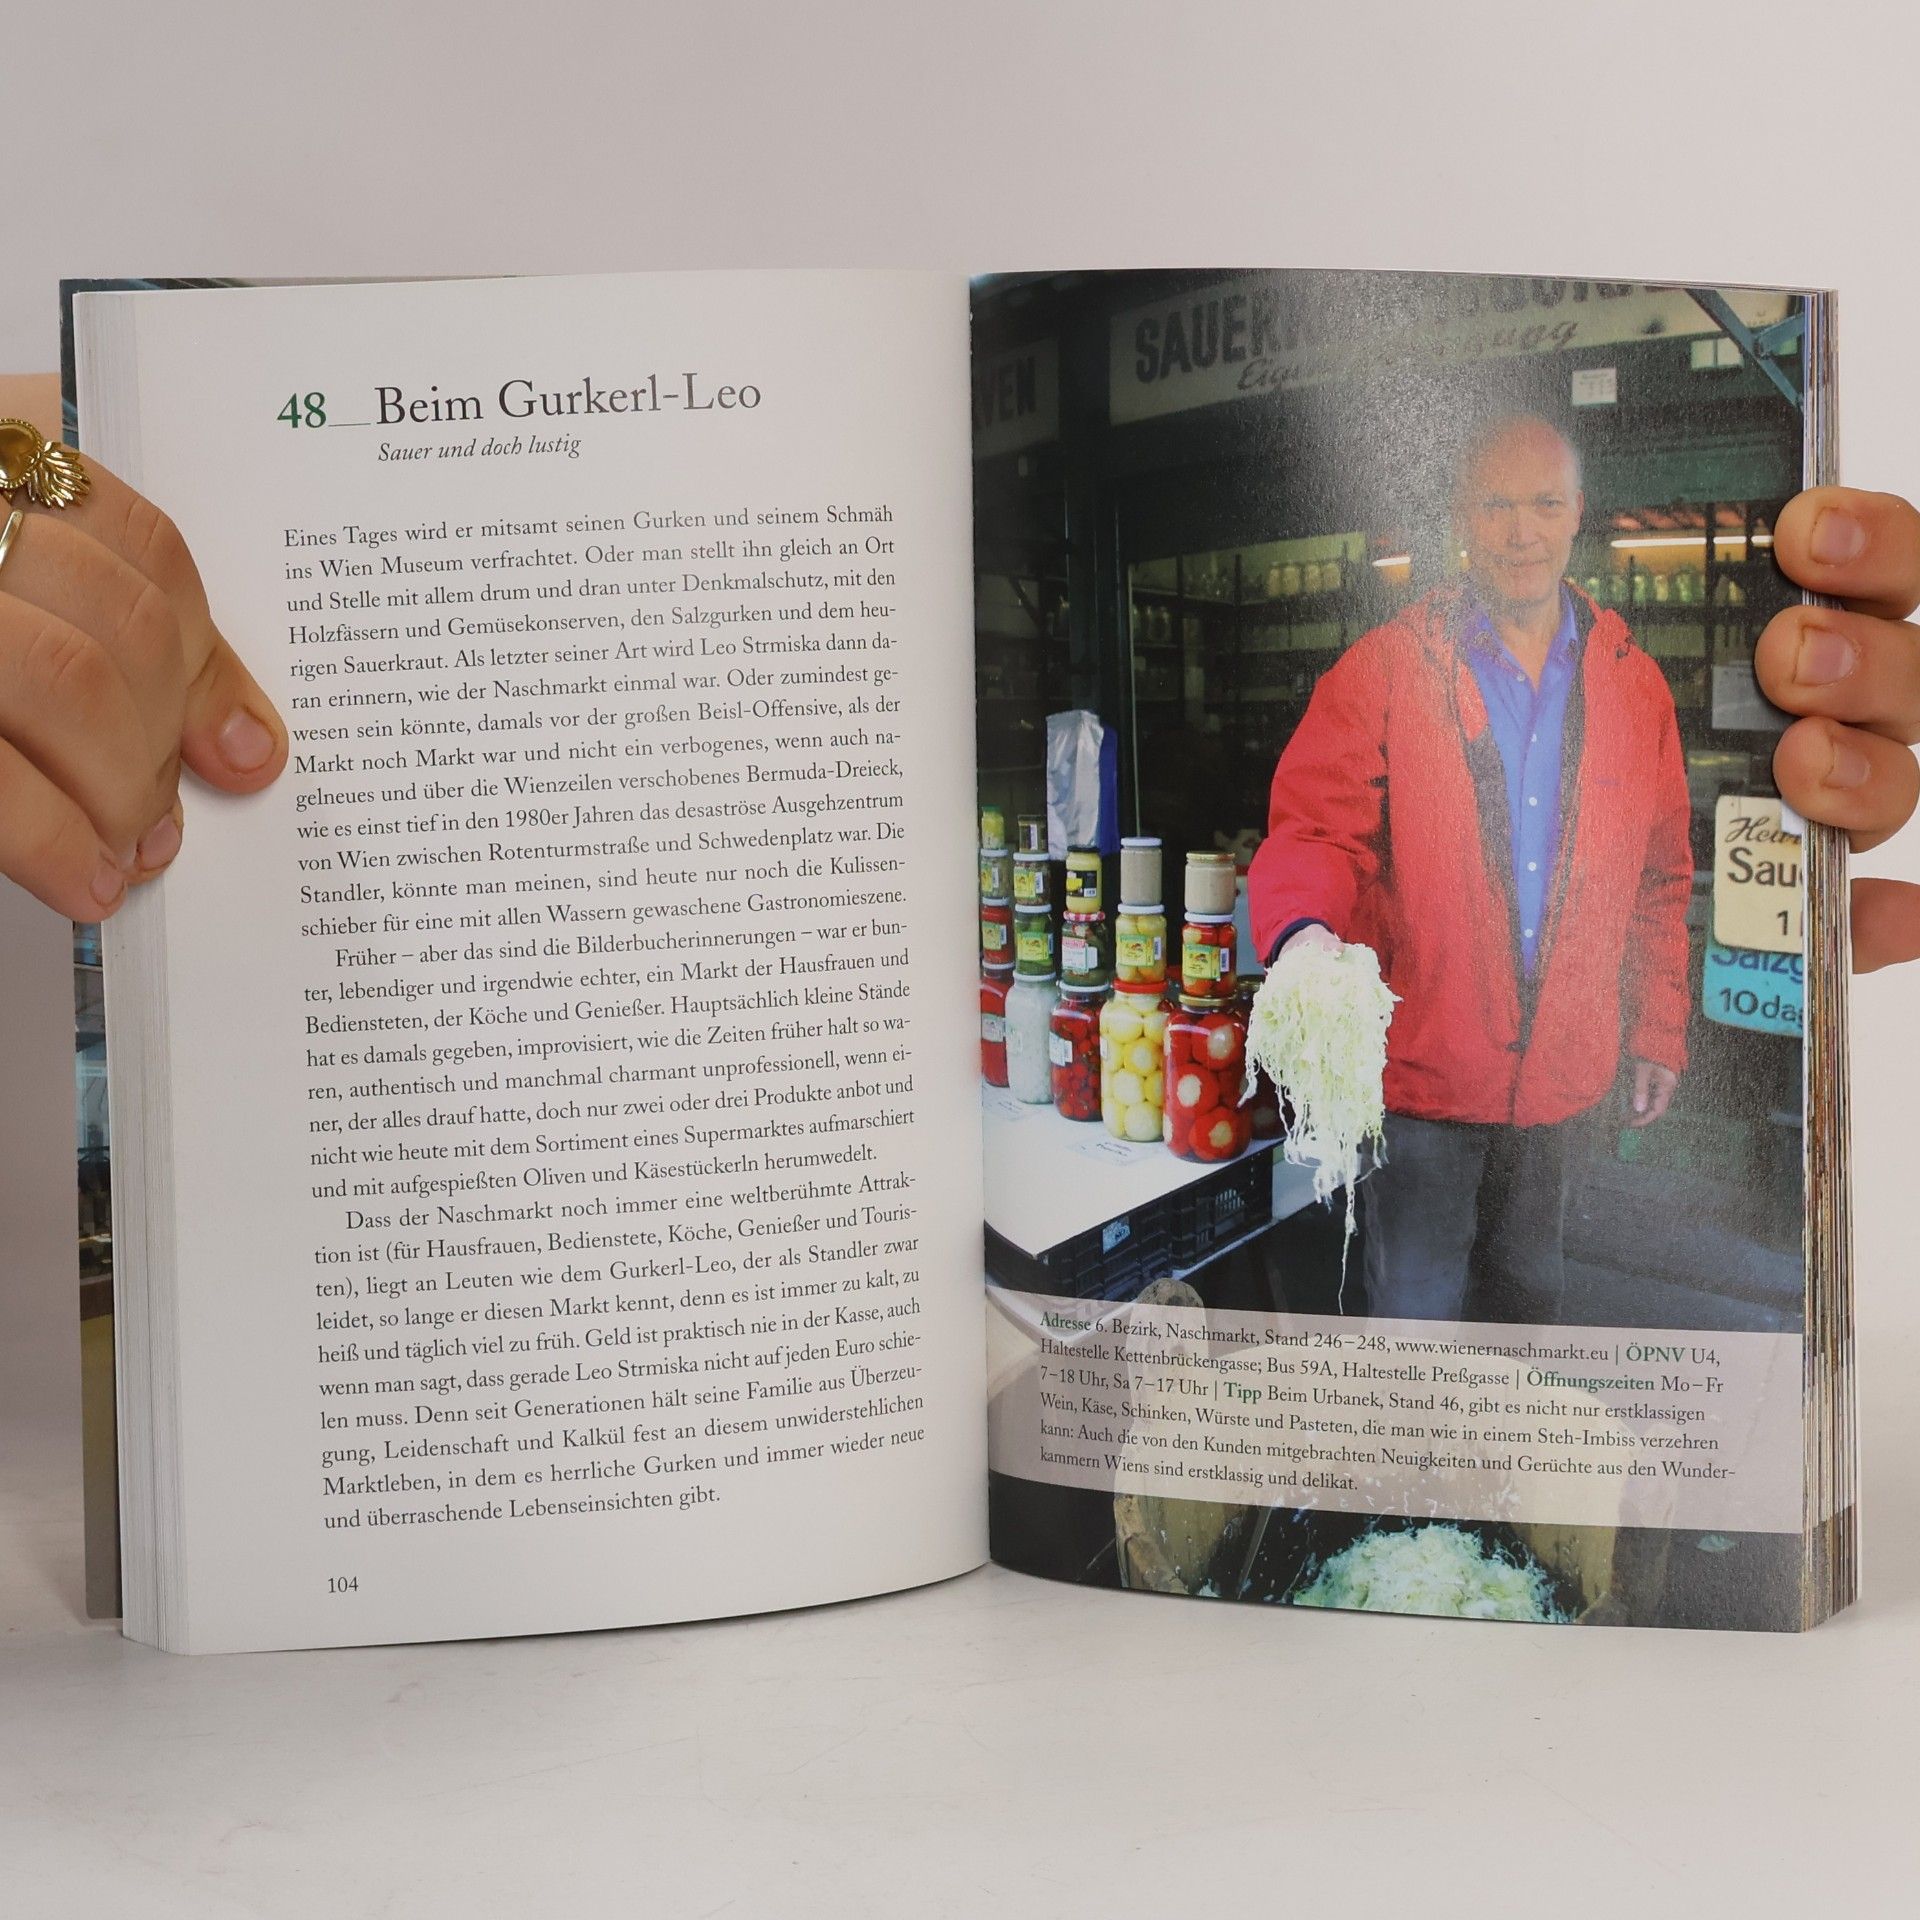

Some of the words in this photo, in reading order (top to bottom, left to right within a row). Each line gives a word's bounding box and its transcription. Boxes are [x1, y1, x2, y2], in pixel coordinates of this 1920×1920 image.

[374, 386, 484, 425] Beim
[498, 373, 762, 418] Gurkerl-Leo
[378, 443, 432, 462] Sauer
[438, 439, 476, 459] und
[481, 436, 522, 456] doch
[528, 434, 582, 459] lustig
[283, 528, 337, 548] Eines
[342, 525, 398, 549] Tages
[404, 521, 448, 541] wird
[455, 525, 474, 539] er
[481, 518, 558, 537] mitsamt
[566, 514, 626, 533] seinen
[633, 510, 706, 530] Gurken
[713, 507, 749, 527] und
[756, 507, 819, 525] seinem
[826, 504, 893, 523] Schmäh
[288, 623, 400, 645] Holzfässern
[405, 618, 442, 638] und
[447, 613, 625, 636] Gemüsekonserven,
[630, 608, 665, 627] den
[671, 604, 773, 629] Salzgurken
[778, 601, 813, 621] und
[818, 601, 855, 620] dem
[860, 600, 896, 618] heu-
[295, 787, 375, 813] gelneues
[380, 781, 417, 802] und
[423, 780, 465, 800] über
[470, 778, 499, 797] die
[503, 773, 613, 795] Wienzeilen
[618, 767, 740, 789] verschobenes
[746, 758, 903, 783] Bermuda-Dreieck,
[297, 858, 333, 871] von
[336, 850, 391, 869] Wien
[396, 845, 482, 866] zwischen
[488, 835, 650, 861] Rotenturmstraße
[655, 832, 692, 853] und
[698, 826, 834, 852] Schwedenplatz
[837, 829, 872, 842] war.
[876, 821, 905, 840] Die
[1727, 846, 1803, 888] Sau
[301, 915, 378, 937] schieber
[383, 913, 410, 932] für
[415, 912, 454, 931] eine
[459, 909, 492, 928] mit
[497, 906, 542, 926] allen
[546, 904, 627, 923] Wassern
[632, 897, 741, 925] gewaschene
[747, 888, 907, 912] Gastronomieszene.
[304, 1014, 429, 1035] Bediensteten,
[433, 1008, 464, 1028] der
[468, 1005, 528, 1026] Köche
[533, 1002, 570, 1023] und
[574, 998, 665, 1020] Genießer.
[670, 988, 800, 1018] Hauptsächlich
[804, 986, 854, 1006] kleine
[858, 979, 910, 1001] Stände
[1719, 987, 1804, 1029] 10da
[310, 1145, 358, 1166] nicht
[361, 1144, 394, 1163] wie
[397, 1142, 449, 1161] heute
[453, 1139, 486, 1158] mit
[490, 1136, 531, 1156] dem
[535, 1133, 629, 1153] Sortiment
[633, 1129, 679, 1147] eines
[684, 1119, 805, 1149] Supermarktes
[809, 1108, 915, 1134] aufmarschiert
[1039, 1311, 1091, 1331] Adresse
[1095, 1318, 1108, 1333] 6.
[1111, 1318, 1162, 1340] Bezirk,
[1165, 1322, 1260, 1347] Naschmarkt,
[1264, 1328, 1309, 1347] Stand
[1394, 1339, 1609, 1361] www.wienernaschmarkt.eu
[1625, 1341, 1686, 1363] ÖPNV
[1690, 1347, 1721, 1368] U4,
[1040, 1337, 1110, 1360] Haltestelle
[1113, 1345, 1262, 1375] Kettenbrückengasse;
[1266, 1356, 1295, 1374] Bus
[1299, 1359, 1338, 1380] 59A,
[1342, 1361, 1426, 1382] Haltestelle
[1431, 1365, 1510, 1389] Preßgasse
[1526, 1366, 1655, 1394] Öffnungszeiten
[1040, 1391, 1078, 1414] Wein,
[1082, 1397, 1117, 1419] Käse,
[1121, 1401, 1192, 1425] Schinken,
[1194, 1407, 1250, 1427] Würste
[1254, 1413, 1284, 1429] und
[1289, 1414, 1358, 1437] Pasteten,
[1362, 1418, 1386, 1436] die
[1390, 1426, 1425, 1438] man
[1429, 1423, 1458, 1440] wie
[1462, 1424, 1478, 1441] in
[1483, 1426, 1532, 1443] einem
[1537, 1427, 1636, 1447] Steh-Imbiss
[1639, 1433, 1719, 1450] verzehren
[1078, 1369, 1109, 1390] Uhr,
[1113, 1372, 1130, 1390] Sa
[1178, 1378, 1209, 1396] Uhr
[1222, 1381, 1262, 1405] Tipp
[1267, 1384, 1308, 1403] Beim
[1312, 1387, 1384, 1410] Urbanek,
[1388, 1391, 1435, 1410] Stand
[1439, 1395, 1464, 1415] 46,
[1468, 1396, 1500, 1418] gibt
[1504, 1403, 1521, 1415] es
[1526, 1399, 1568, 1416] nicht
[1572, 1406, 1601, 1417] nur
[1604, 1402, 1705, 1426] erstklassigen
[321, 1448, 376, 1469] gung,
[383, 1433, 510, 1459] Leidenschaft
[517, 1430, 554, 1451] und
[562, 1425, 626, 1448] Kalkül
[633, 1423, 667, 1443] fest
[674, 1426, 697, 1440] an
[704, 1417, 768, 1437] diesem
[775, 1394, 924, 1430] unwiderstehlichen
[1041, 1419, 1075, 1438] kann:
[1077, 1426, 1113, 1443] Auch
[1117, 1428, 1138, 1445] die
[1142, 1436, 1168, 1448] von
[1172, 1433, 1199, 1451] den
[1203, 1435, 1262, 1456] Kunden
[1266, 1443, 1376, 1464] mitgebrachten
[1381, 1447, 1477, 1472] Neuigkeiten
[1481, 1454, 1513, 1471] und
[1517, 1455, 1593, 1474] Gerüchte
[1597, 1463, 1623, 1475] aus
[1628, 1460, 1657, 1476] den
[1661, 1461, 1736, 1479] Wunder-
[1041, 1447, 1100, 1469] kammern
[1105, 1454, 1150, 1474] Wiens
[1154, 1461, 1184, 1477] sind
[1188, 1465, 1264, 1489] erstklassig
[1269, 1471, 1298, 1486] und
[1302, 1472, 1358, 1491] delikat.
[323, 1508, 361, 1529] und
[367, 1500, 503, 1527] überraschende
[508, 1490, 674, 1518] Lebenseinsichten
[679, 1484, 721, 1511] gibt.
[327, 1576, 359, 1593] 104
